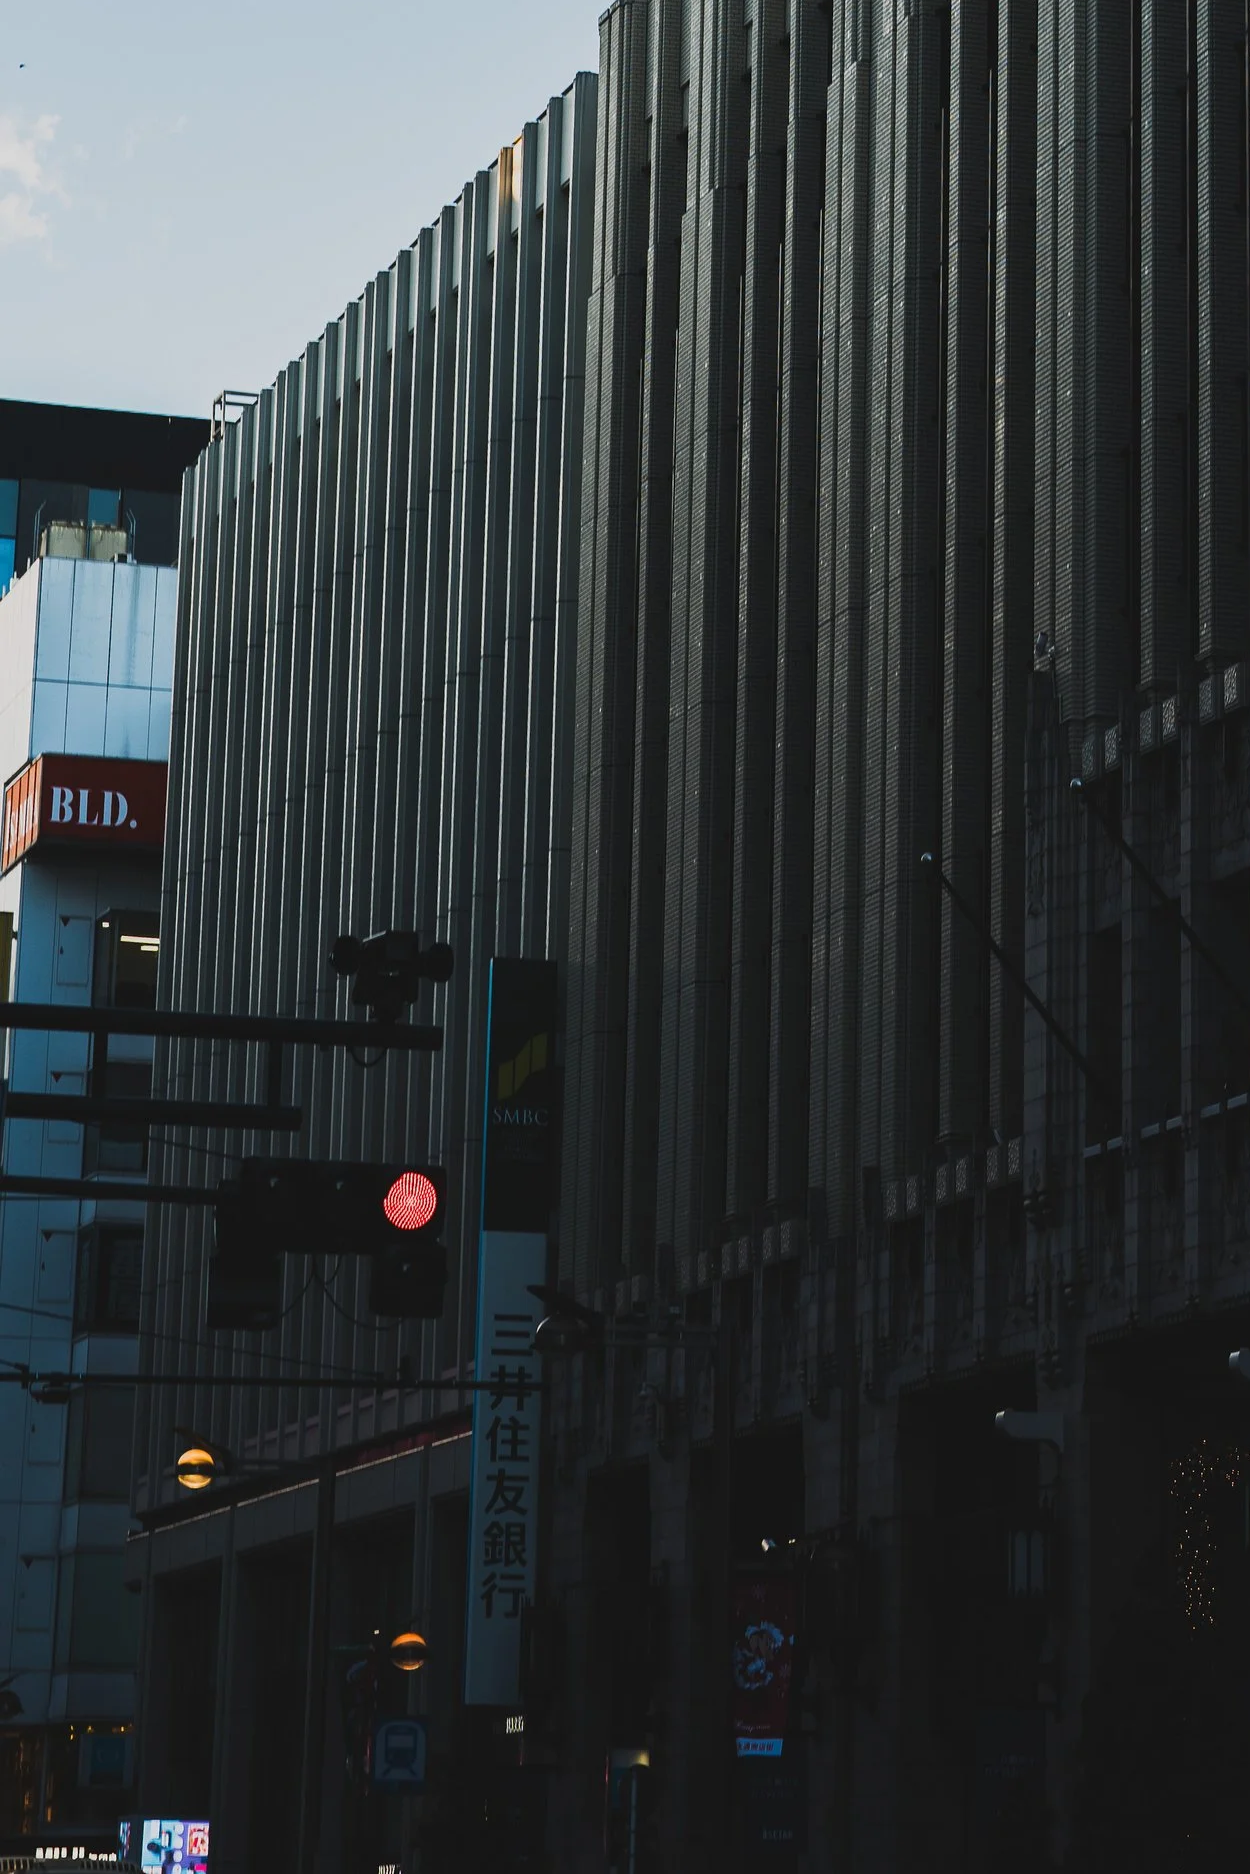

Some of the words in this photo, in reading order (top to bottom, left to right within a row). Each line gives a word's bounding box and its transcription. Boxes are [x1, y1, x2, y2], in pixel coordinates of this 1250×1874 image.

[50, 785, 138, 829] BLD.
[492, 1107, 549, 1127] SMBC
[480, 1313, 534, 1620] 三井住友銀行
